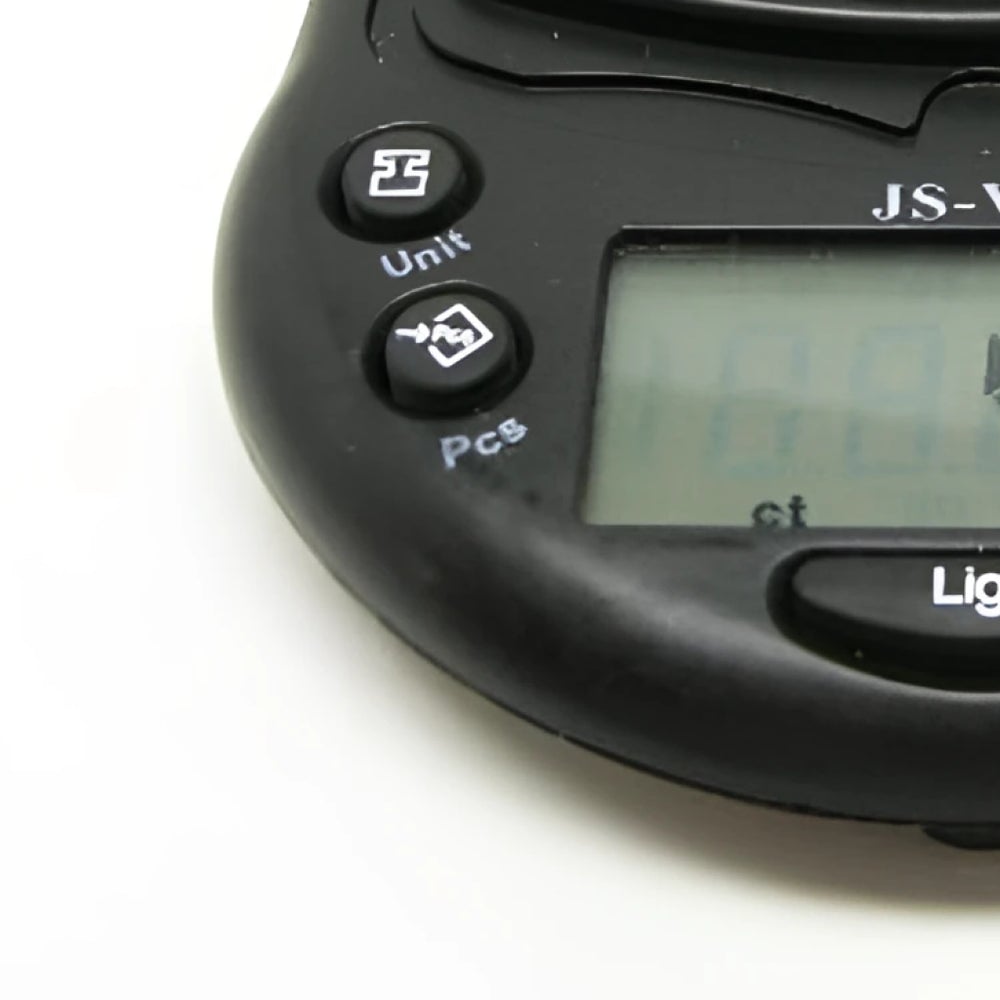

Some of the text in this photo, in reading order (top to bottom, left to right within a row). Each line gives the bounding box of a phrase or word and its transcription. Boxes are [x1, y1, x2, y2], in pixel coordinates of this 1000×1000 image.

[379, 229, 472, 278] Unit
[439, 417, 528, 470] Pcs
[752, 495, 808, 527] ct
